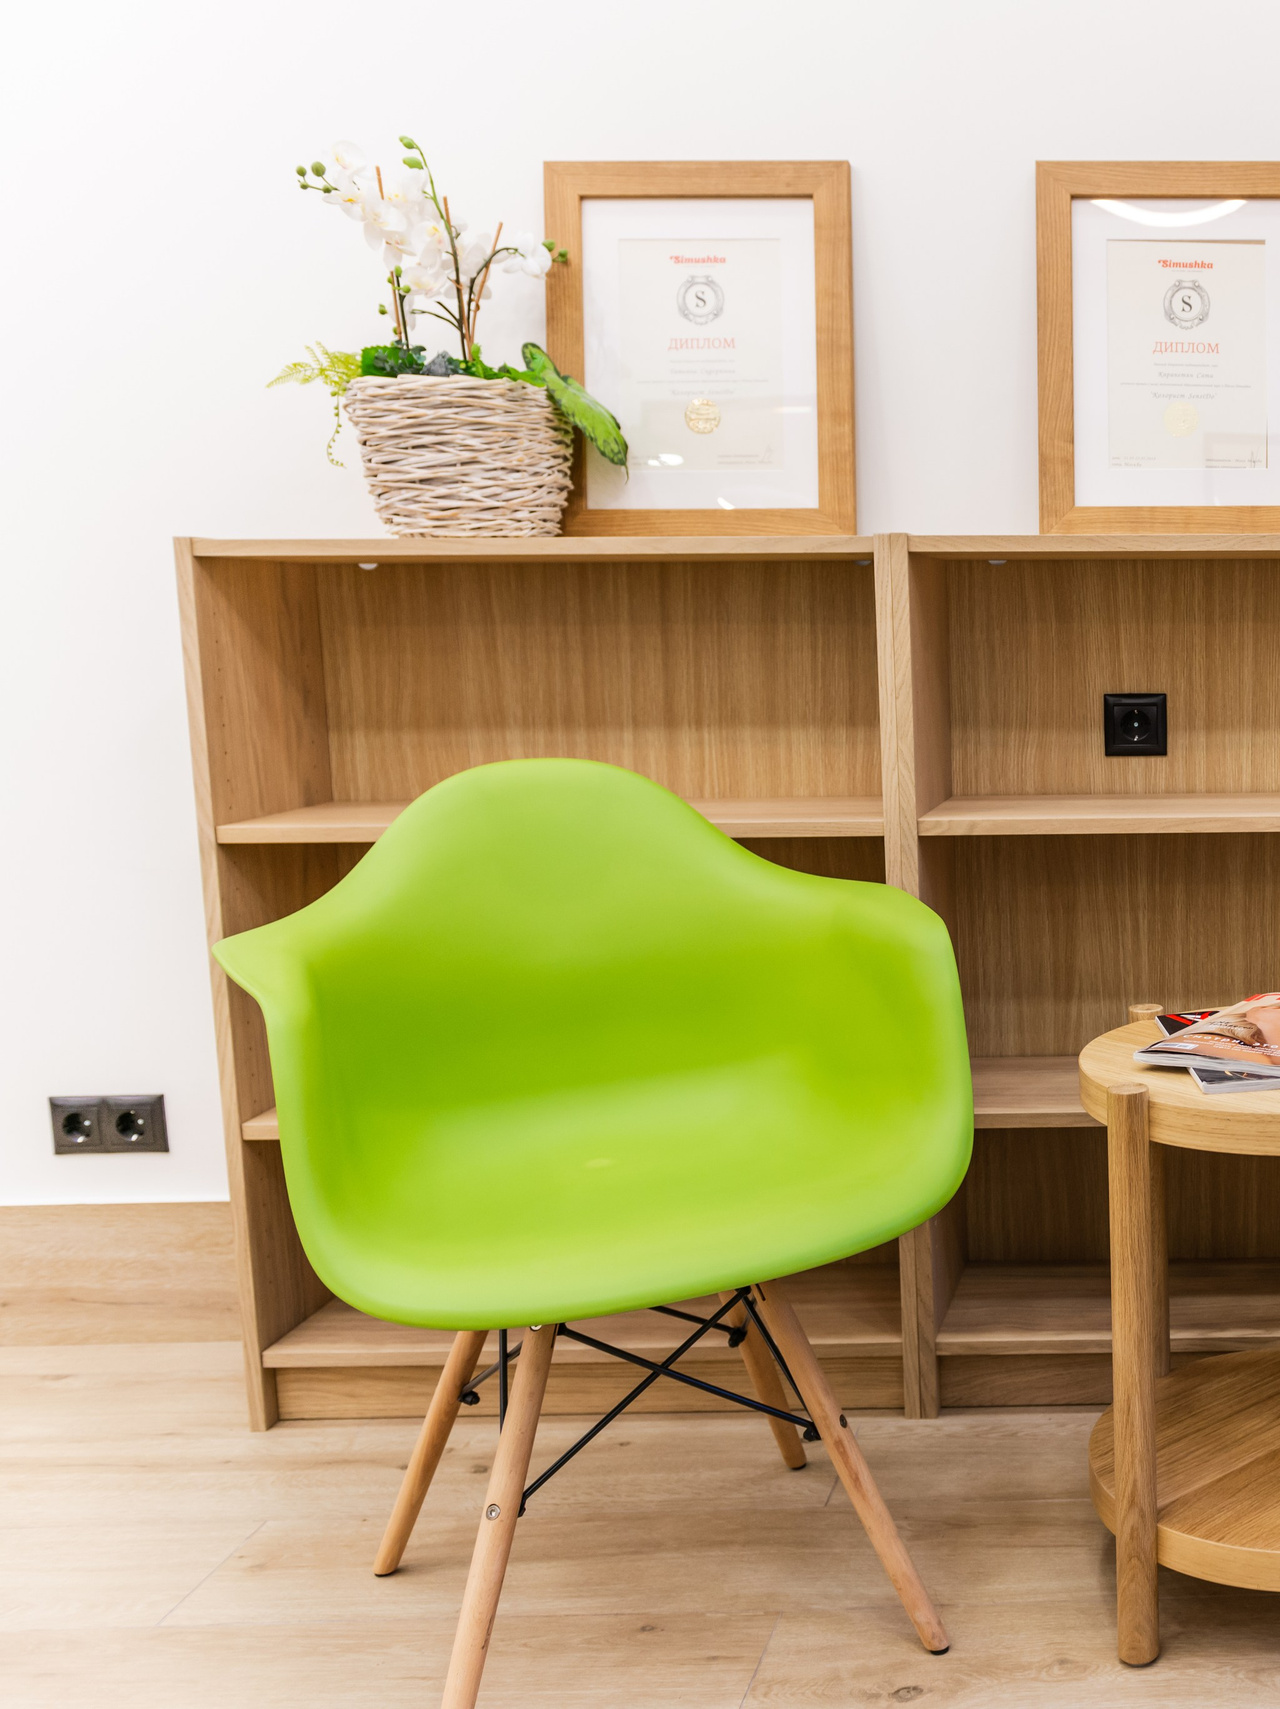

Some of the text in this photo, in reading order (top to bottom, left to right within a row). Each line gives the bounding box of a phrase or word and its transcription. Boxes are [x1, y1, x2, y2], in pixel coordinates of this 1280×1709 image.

[669, 255, 727, 264] Simushka
[1157, 259, 1213, 269] Simushka
[694, 290, 707, 309] S
[1181, 295, 1193, 313] S
[668, 338, 736, 351] ДИПЛОМ
[1153, 341, 1220, 354] ДИПЛОМ
